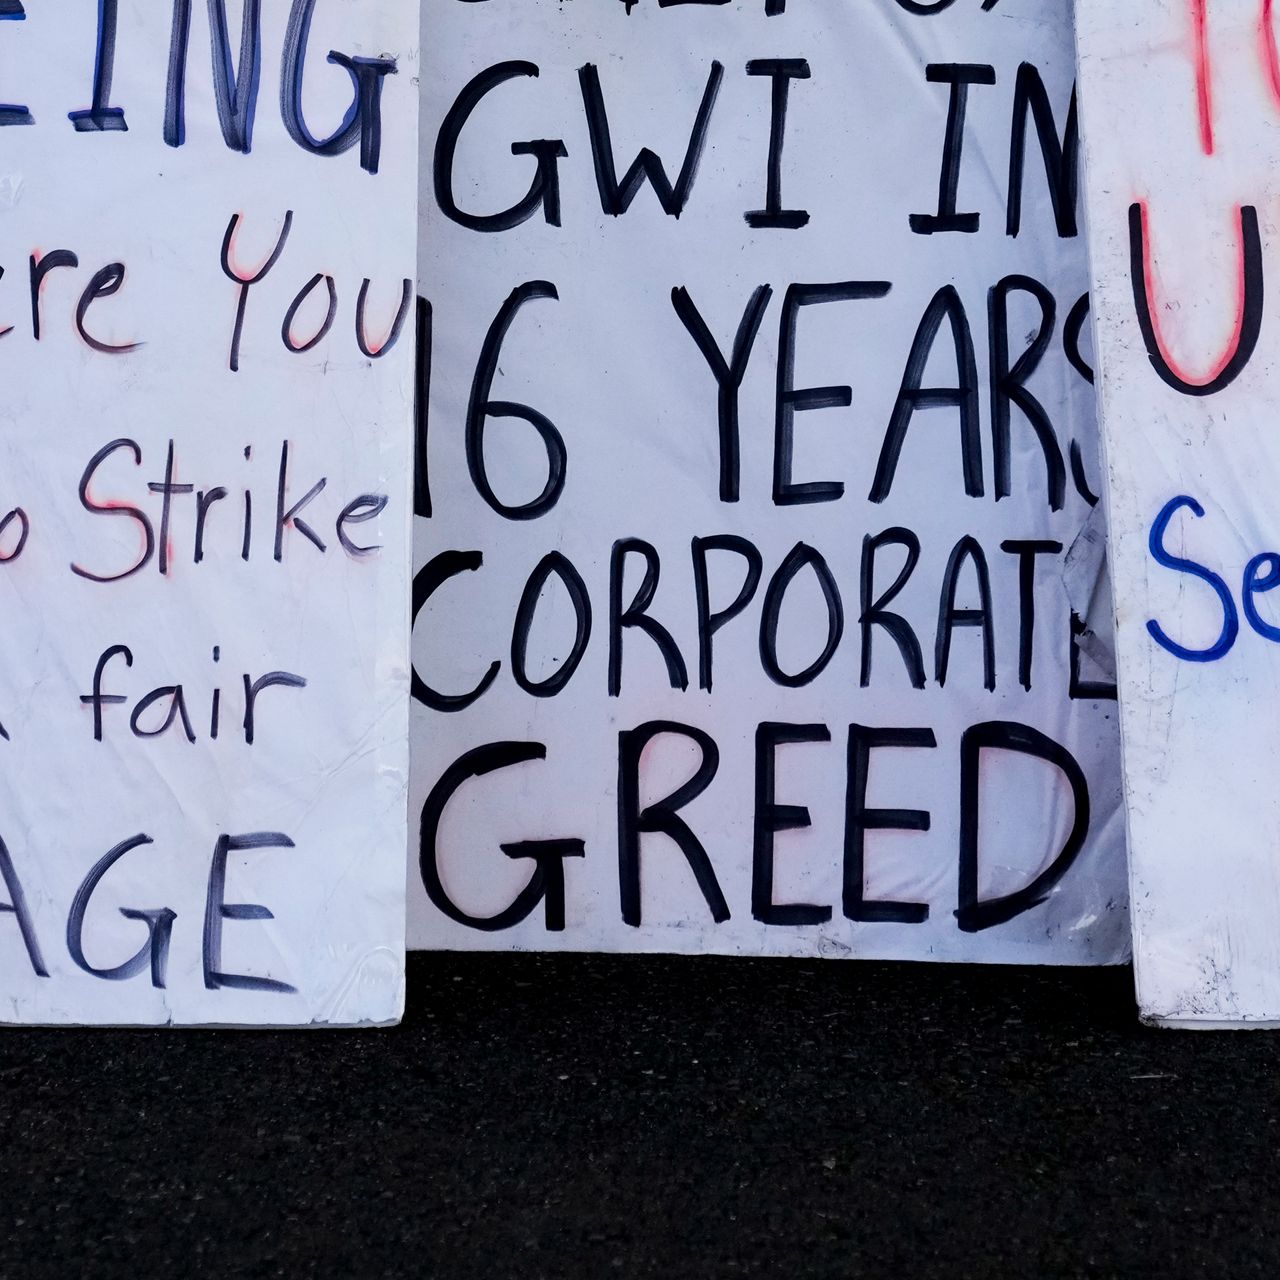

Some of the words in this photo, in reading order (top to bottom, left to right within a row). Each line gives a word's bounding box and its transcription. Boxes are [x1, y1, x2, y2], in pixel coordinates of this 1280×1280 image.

[433, 58, 811, 232] GWI
[909, 61, 1078, 239] IN
[220, 210, 413, 372] You
[415, 281, 567, 520] 16
[70, 437, 389, 582] Strike
[79, 644, 307, 744] fair
[420, 720, 1090, 933] GREED
